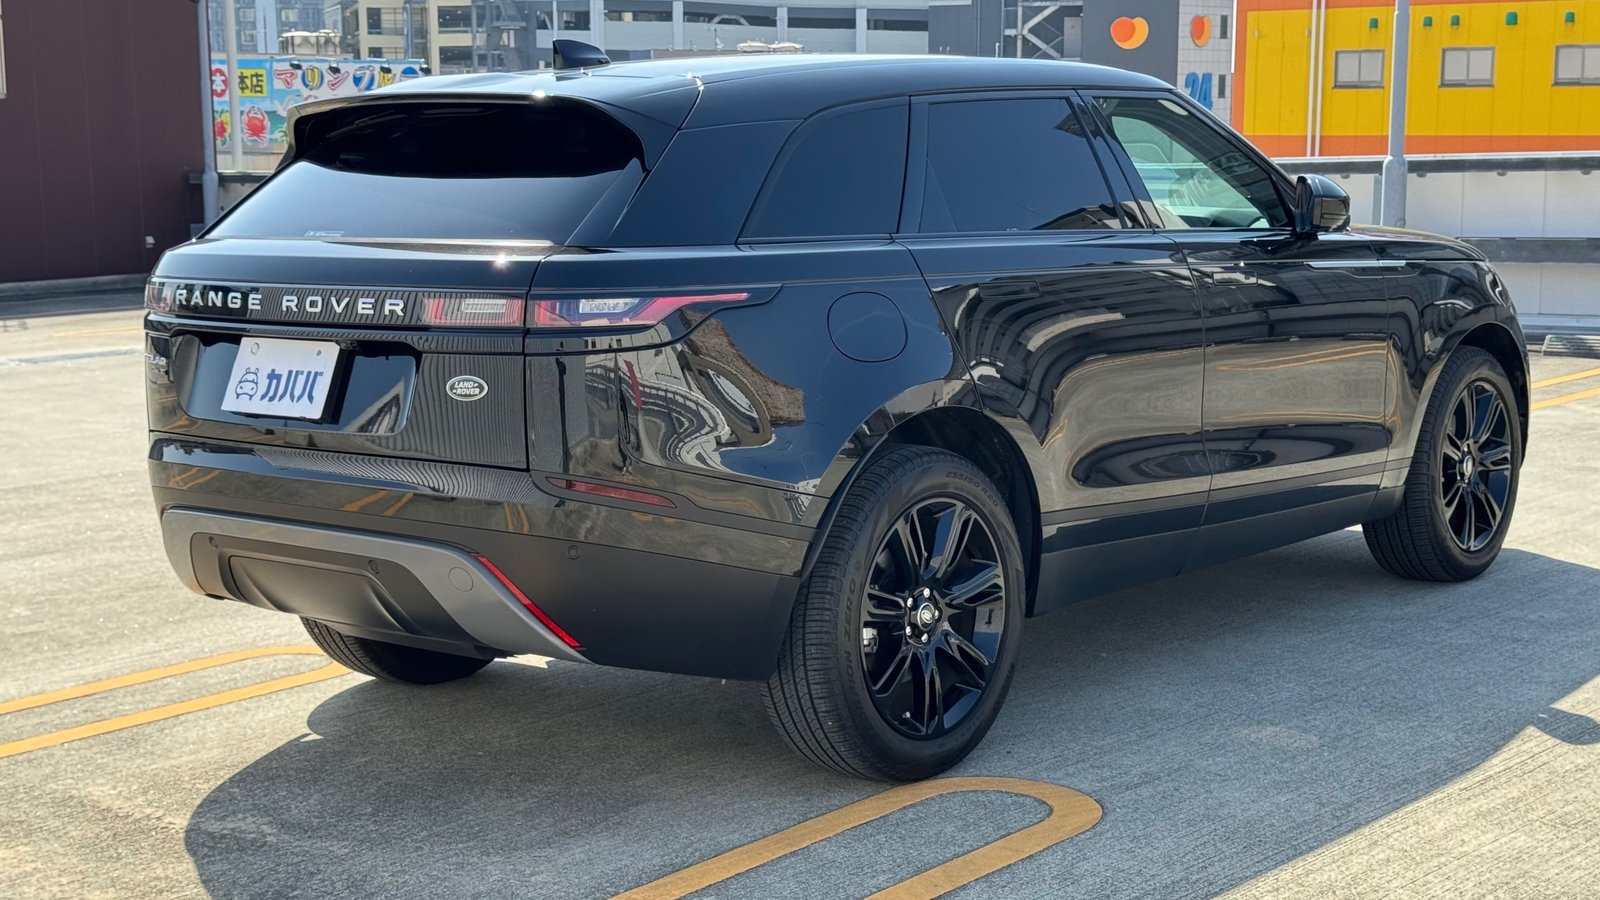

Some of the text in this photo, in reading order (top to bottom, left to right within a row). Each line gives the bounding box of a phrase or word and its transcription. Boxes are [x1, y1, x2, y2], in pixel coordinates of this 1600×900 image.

[238, 71, 265, 95] 本店
[1185, 71, 1213, 111] 24
[175, 289, 405, 316] RANGE ROVER
[843, 577, 856, 641] ZERO
